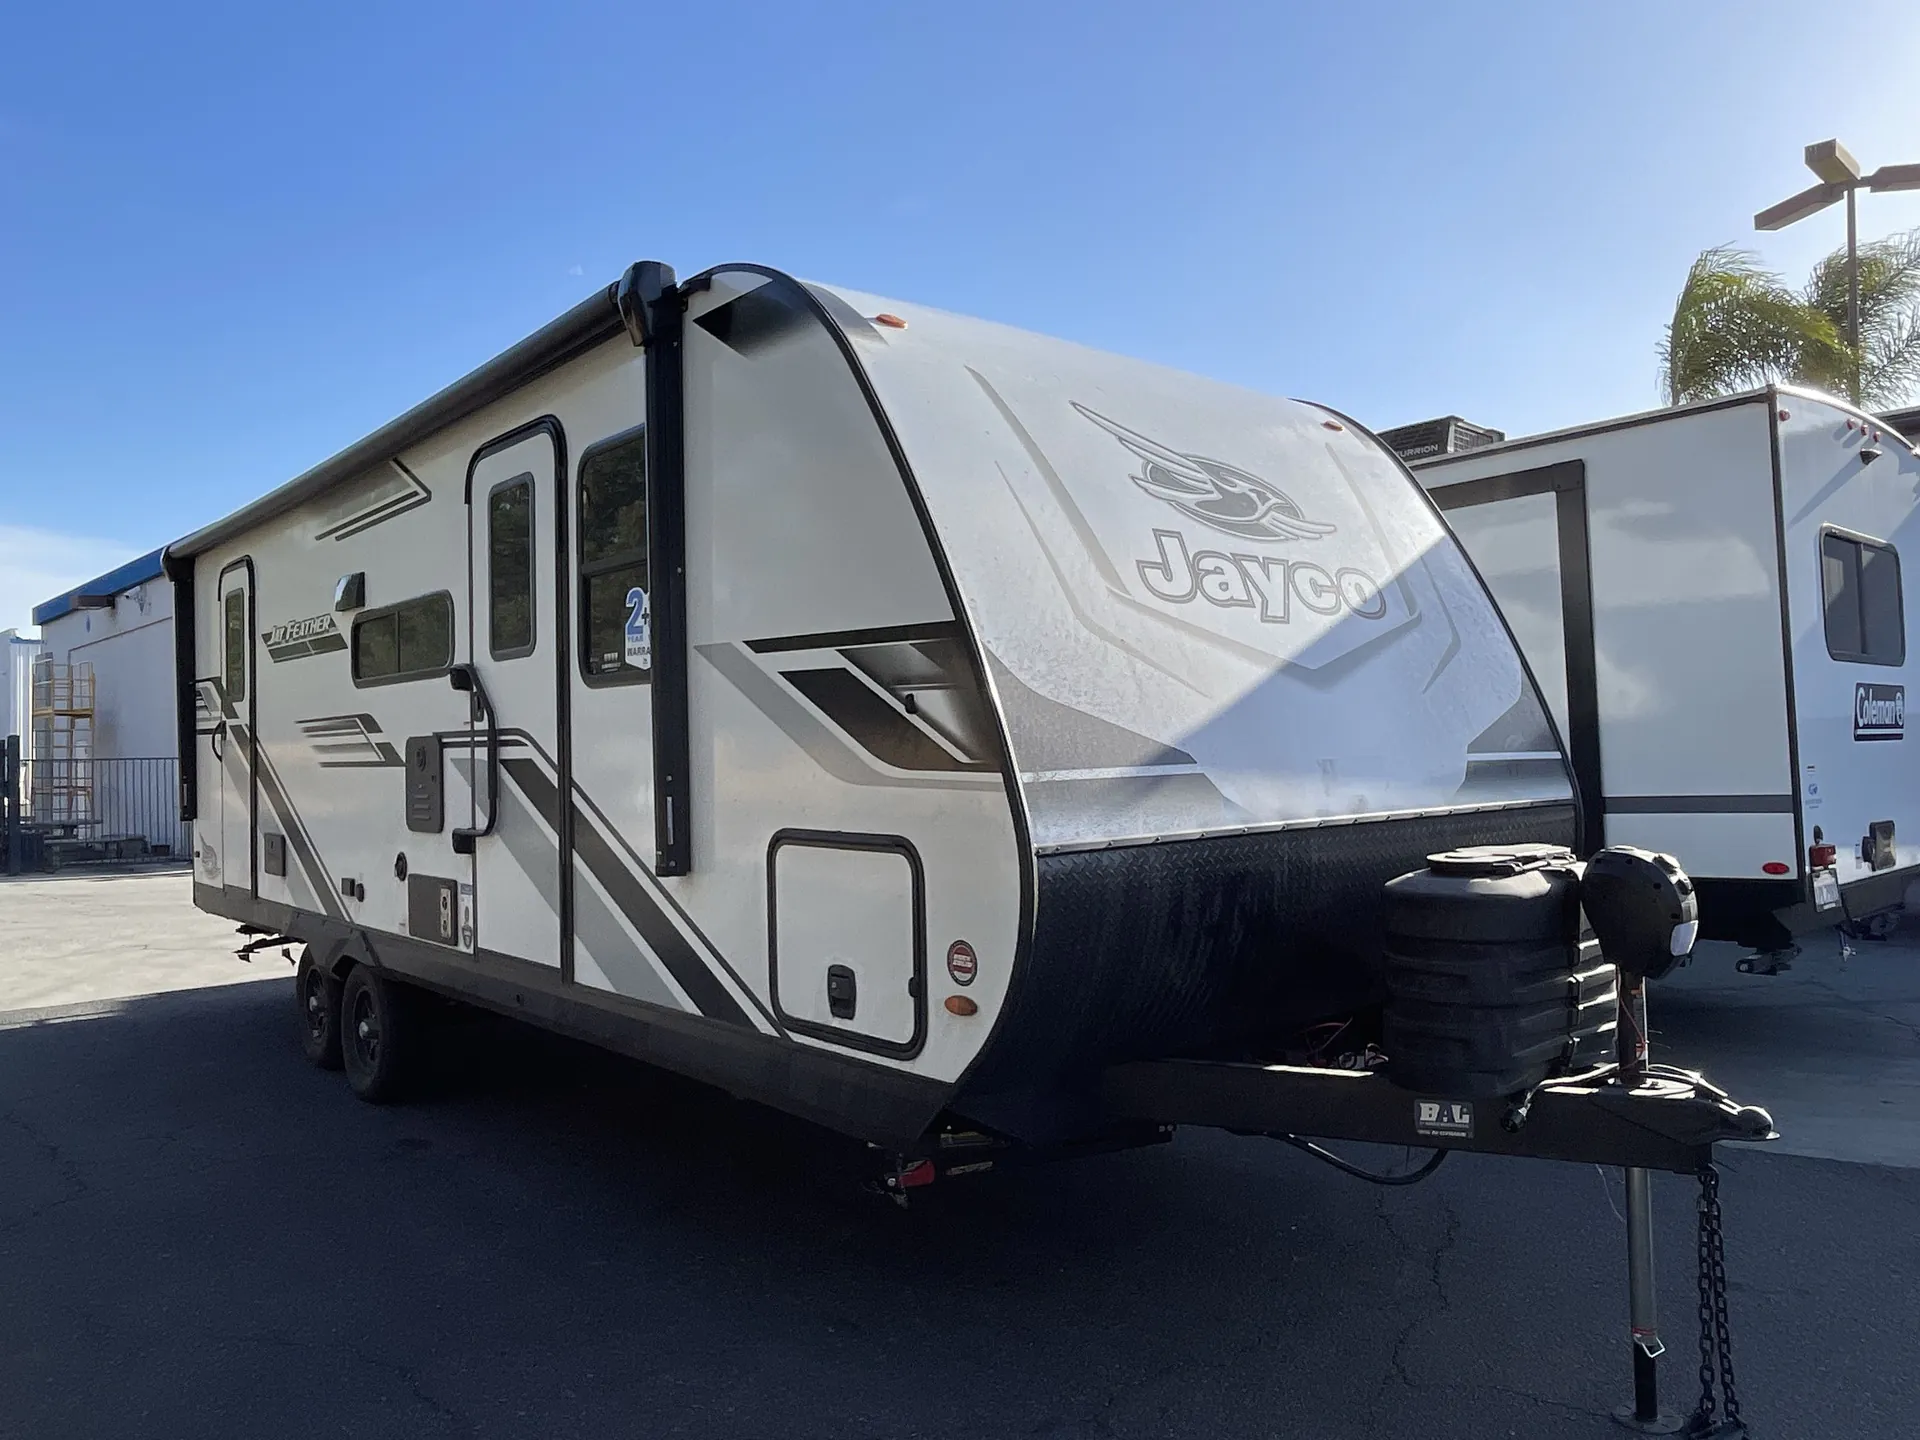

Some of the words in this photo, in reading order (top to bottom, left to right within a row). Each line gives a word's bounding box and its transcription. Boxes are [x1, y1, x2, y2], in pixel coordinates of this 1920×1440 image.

[1135, 528, 1386, 624] Jayco
[286, 615, 331, 641] FEATHER
[627, 646, 652, 657] WARRA
[1857, 687, 1896, 727] Coleman
[1420, 1103, 1470, 1124] BAL
